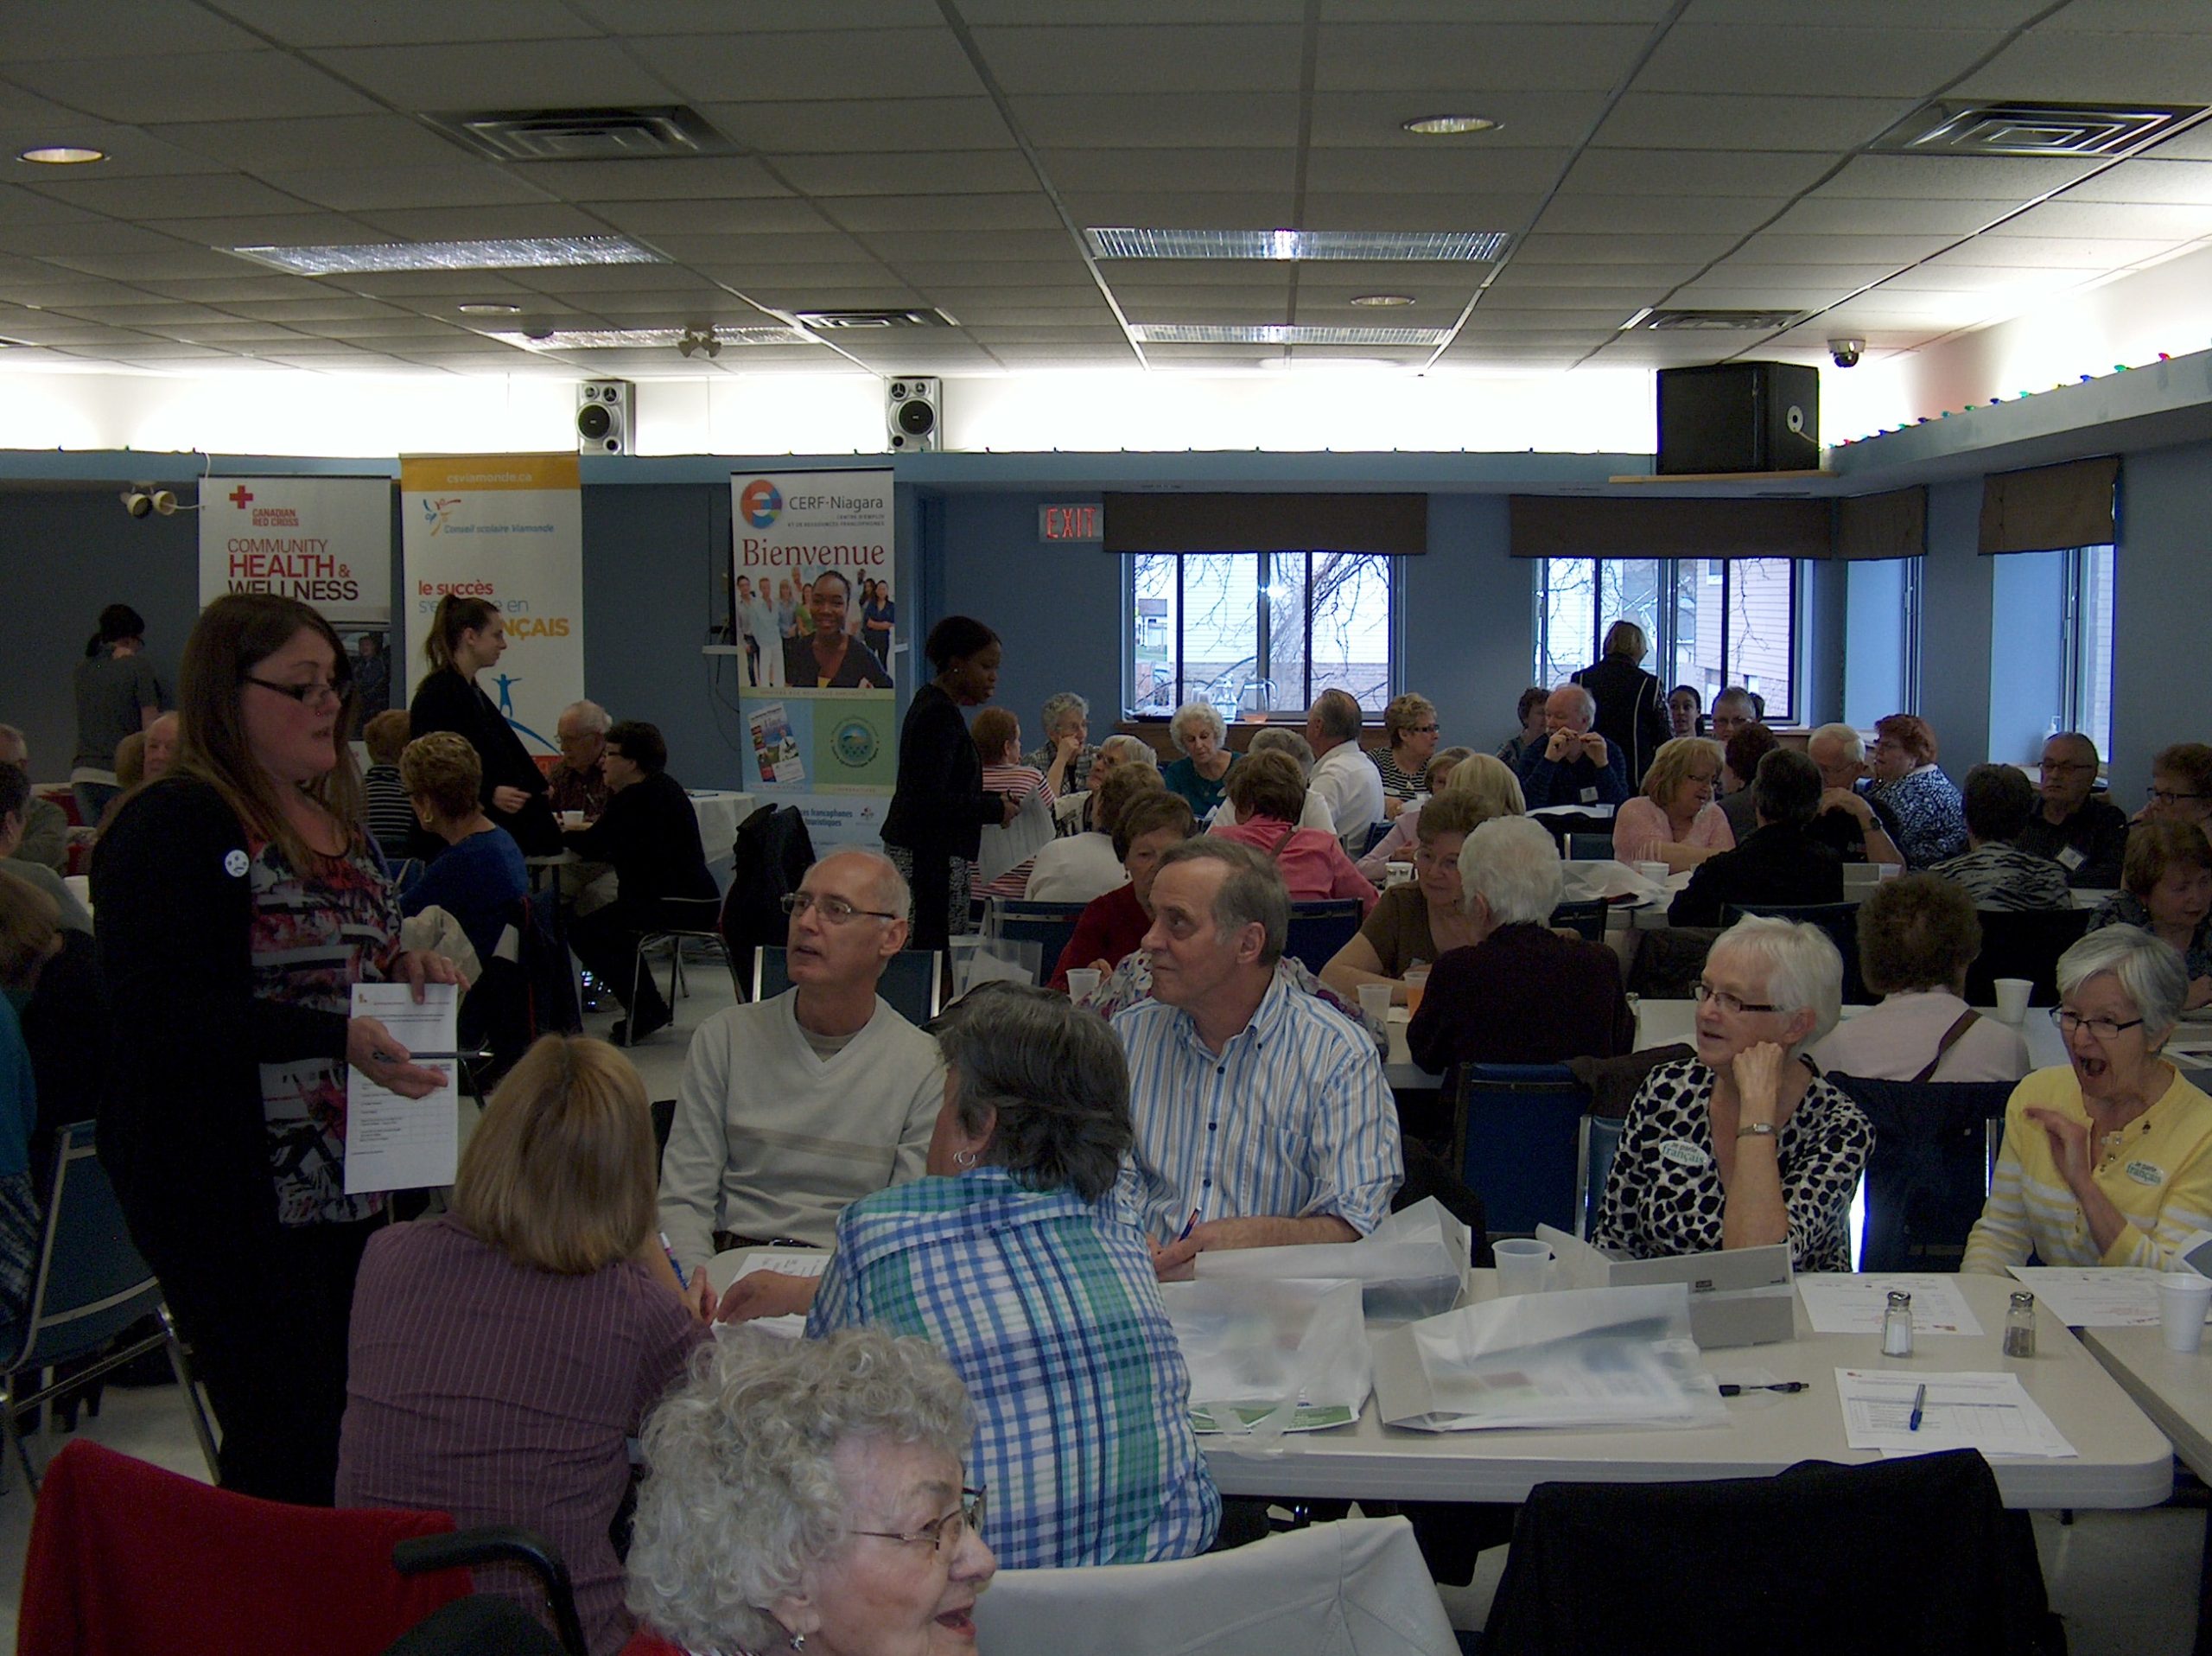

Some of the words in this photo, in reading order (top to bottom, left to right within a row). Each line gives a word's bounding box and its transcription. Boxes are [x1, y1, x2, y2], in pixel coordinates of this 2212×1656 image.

[790, 496, 884, 513] CERF-Niagara
[252, 509, 296, 518] CANADIAN
[1046, 506, 1096, 538] EXIT
[228, 538, 327, 553] COMMUNITY
[742, 538, 884, 566] Bienvenue
[230, 554, 334, 577] HEALTH
[339, 564, 351, 578] &
[418, 581, 433, 596] le
[437, 580, 494, 596] succès
[507, 600, 529, 614] en
[503, 618, 570, 640] NÇAIS
